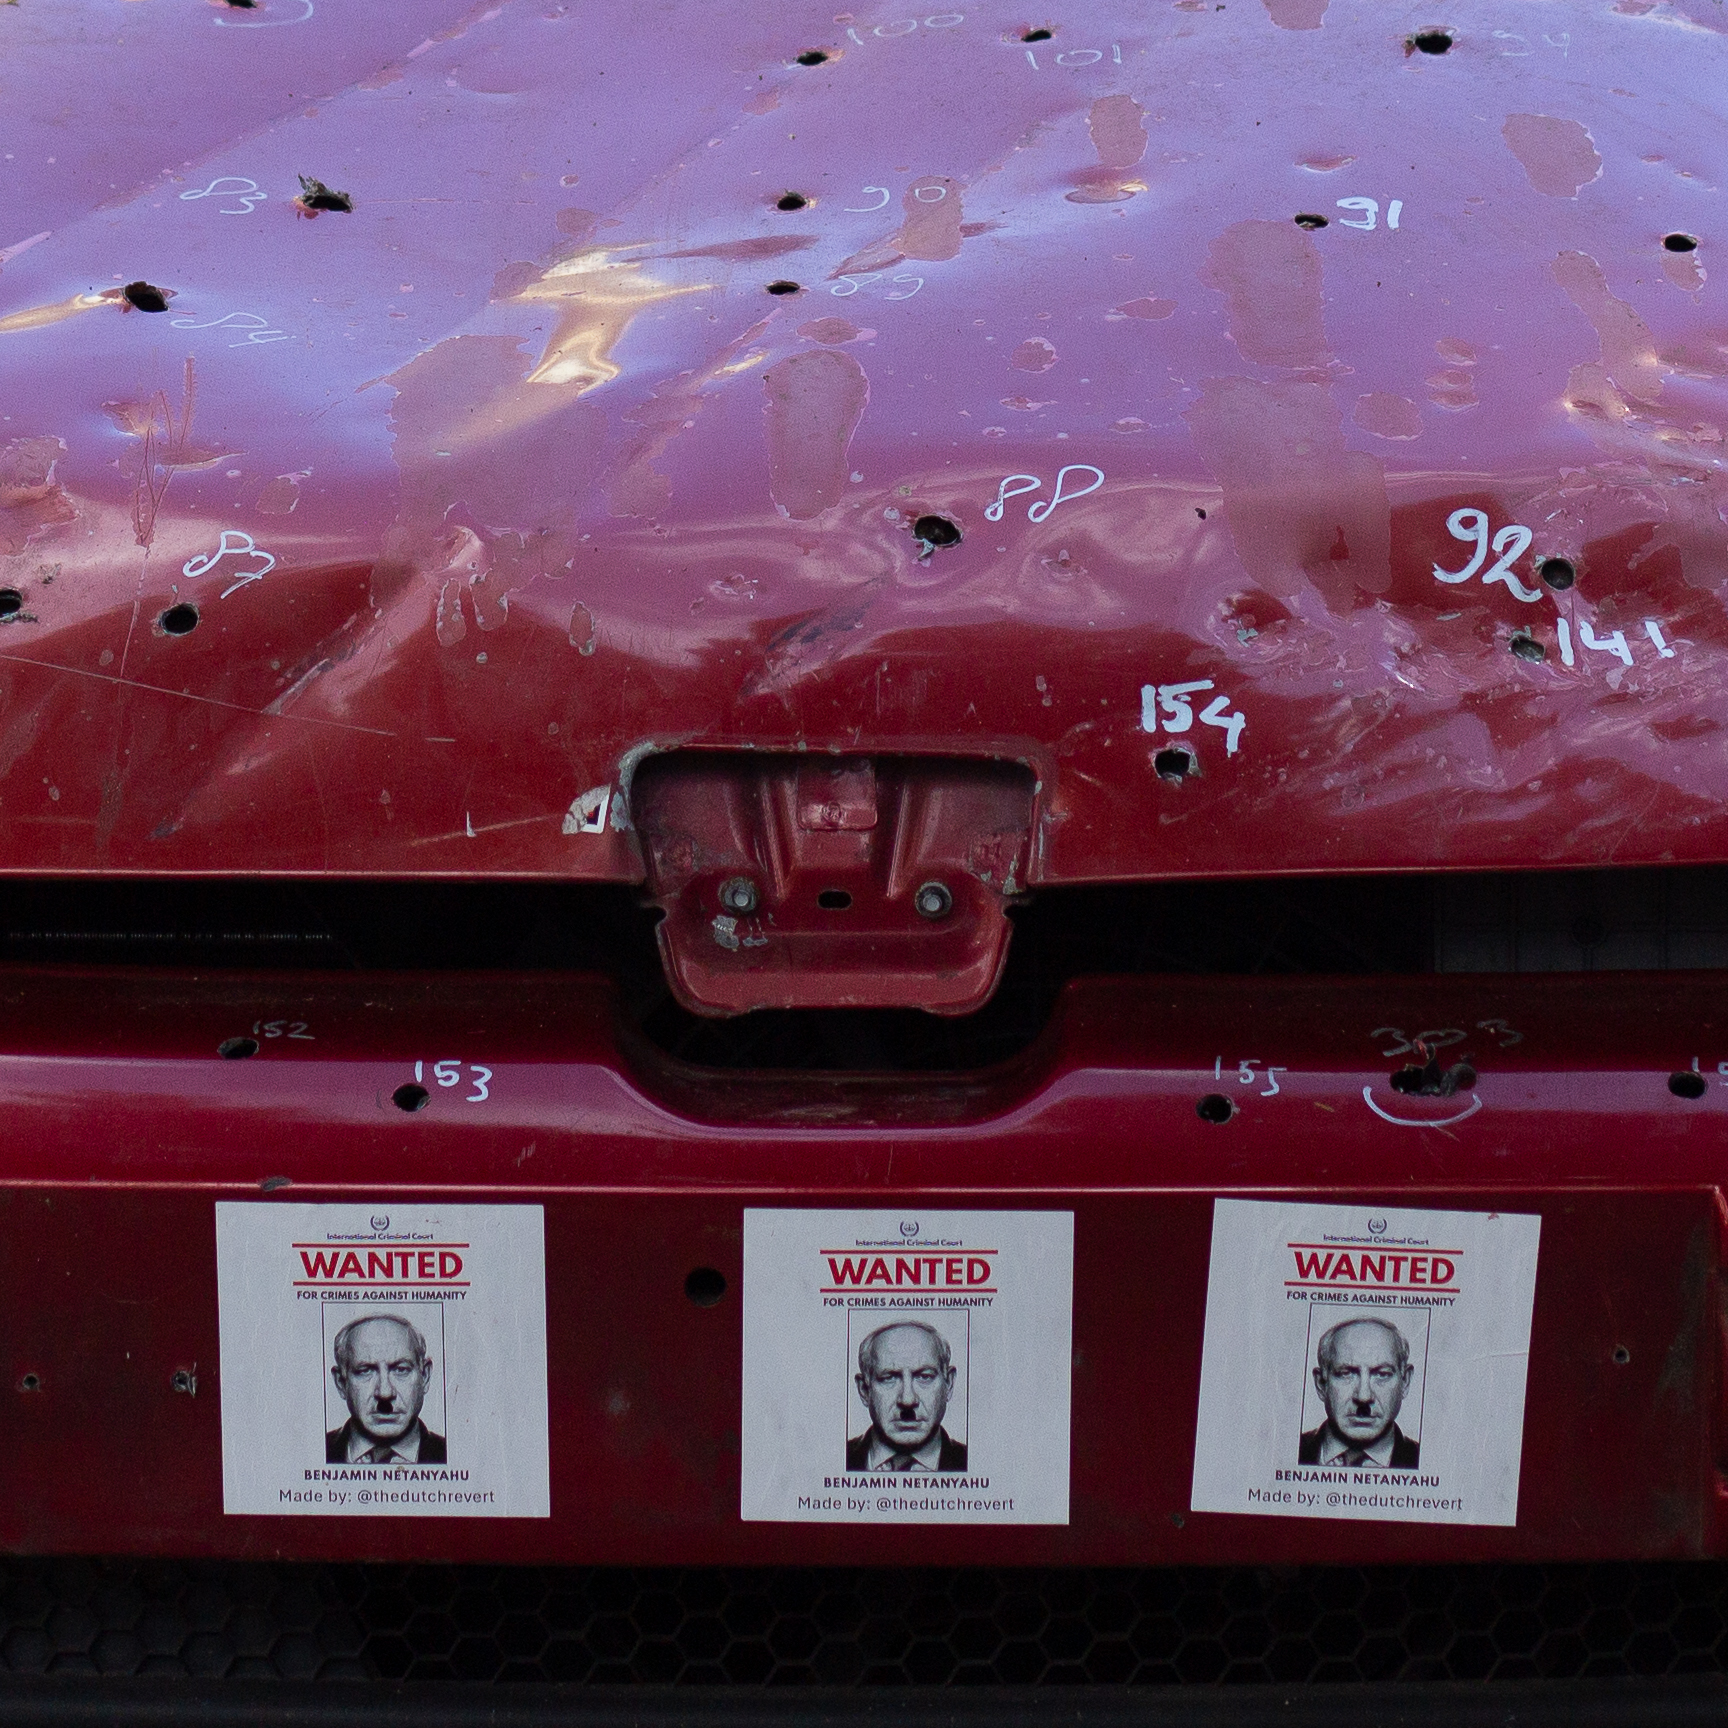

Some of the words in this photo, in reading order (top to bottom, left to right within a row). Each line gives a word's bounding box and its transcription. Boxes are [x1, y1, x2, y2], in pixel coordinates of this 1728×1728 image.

[846, 13, 965, 46] 100
[1336, 195, 1404, 232] 91
[983, 463, 1106, 524] 88
[1432, 507, 1543, 603] 92
[1140, 679, 1247, 757] 154
[252, 1019, 316, 1041] 152
[414, 1060, 494, 1103] 153
[1215, 1055, 1288, 1096] 155
[299, 1250, 464, 1280] WANTED
[827, 1257, 992, 1286] WANTED
[1293, 1250, 1456, 1285] WANTED
[296, 1290, 318, 1301] FOR
[320, 1290, 360, 1301] CRIMES
[362, 1290, 409, 1301] AGAINST
[411, 1290, 468, 1301] HUMANITY
[823, 1297, 845, 1307] FOR
[847, 1297, 886, 1307] CRIMES
[888, 1297, 935, 1307] AGAINST
[938, 1297, 994, 1307] HUMANITY
[1286, 1291, 1308, 1301] FOR
[1310, 1292, 1349, 1303] CRIMES
[1351, 1293, 1398, 1305] AGAINST
[1400, 1295, 1456, 1307] HUMANITY
[304, 1469, 378, 1481] BENJAMIN
[383, 1469, 470, 1481] NETANYAHU
[823, 1477, 898, 1489] BENJAMIN
[902, 1477, 990, 1489] NETANYAHU
[1275, 1469, 1349, 1484] BENJAMIN
[1353, 1473, 1440, 1488] NETANYAHU
[279, 1489, 324, 1503] Made
[328, 1489, 353, 1505] by:
[357, 1489, 496, 1505] @thedutchrevert
[797, 1496, 842, 1511] Made
[847, 1496, 871, 1513] by:
[876, 1496, 1015, 1513] @thedutchrevert
[1247, 1488, 1292, 1504] Made
[1297, 1490, 1321, 1507] by:
[1325, 1491, 1464, 1511] @thedutchrevert
